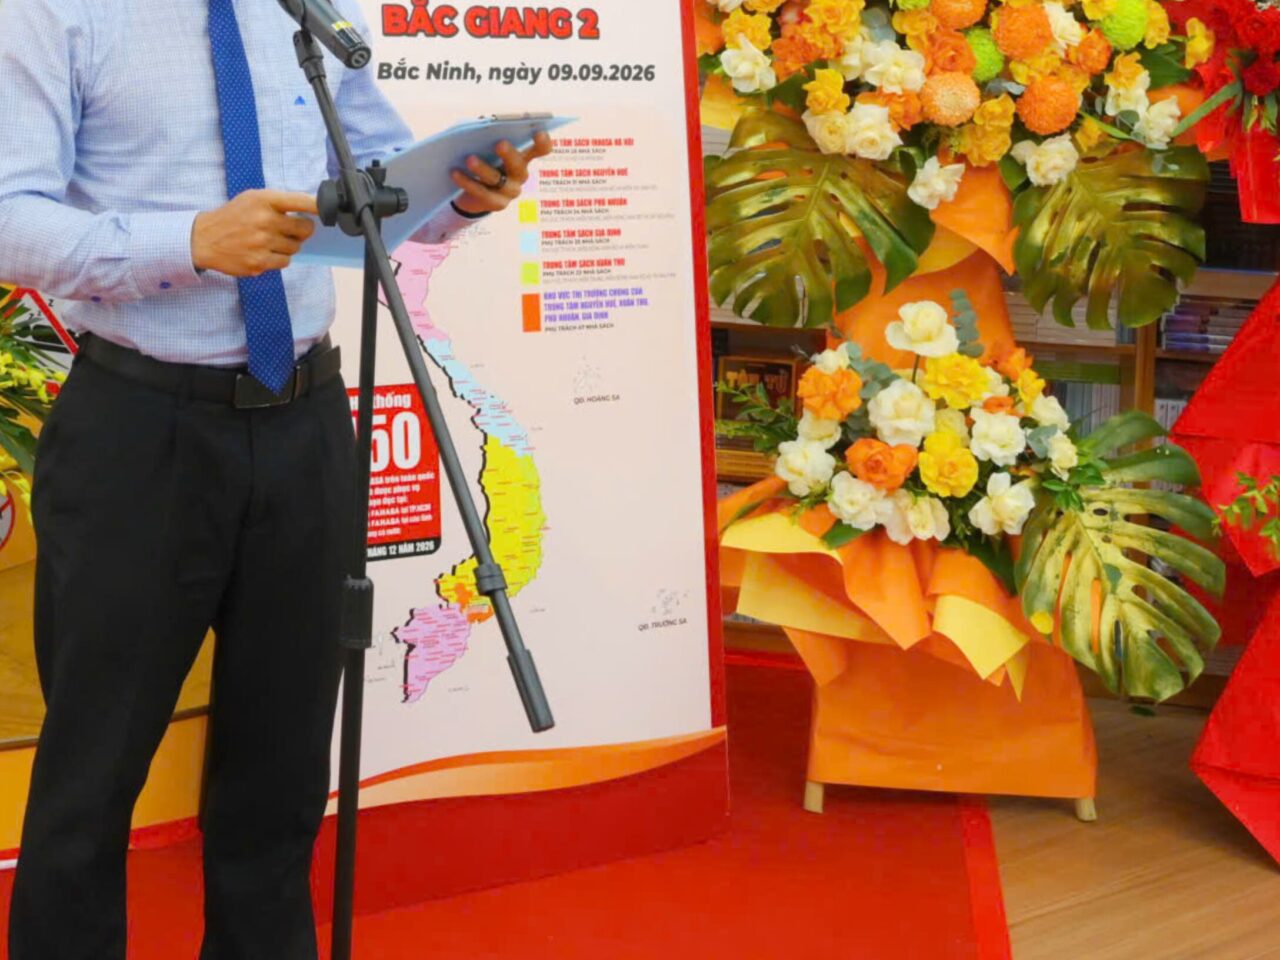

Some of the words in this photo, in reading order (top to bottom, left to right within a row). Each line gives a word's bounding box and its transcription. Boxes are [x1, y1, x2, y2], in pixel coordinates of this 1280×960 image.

[465, 4, 573, 40] GIANG
[577, 8, 600, 40] 2
[378, 56, 420, 81] Bắc
[426, 62, 482, 83] Ninh,
[489, 64, 542, 85] ngày
[548, 63, 655, 82] 09.09.2026
